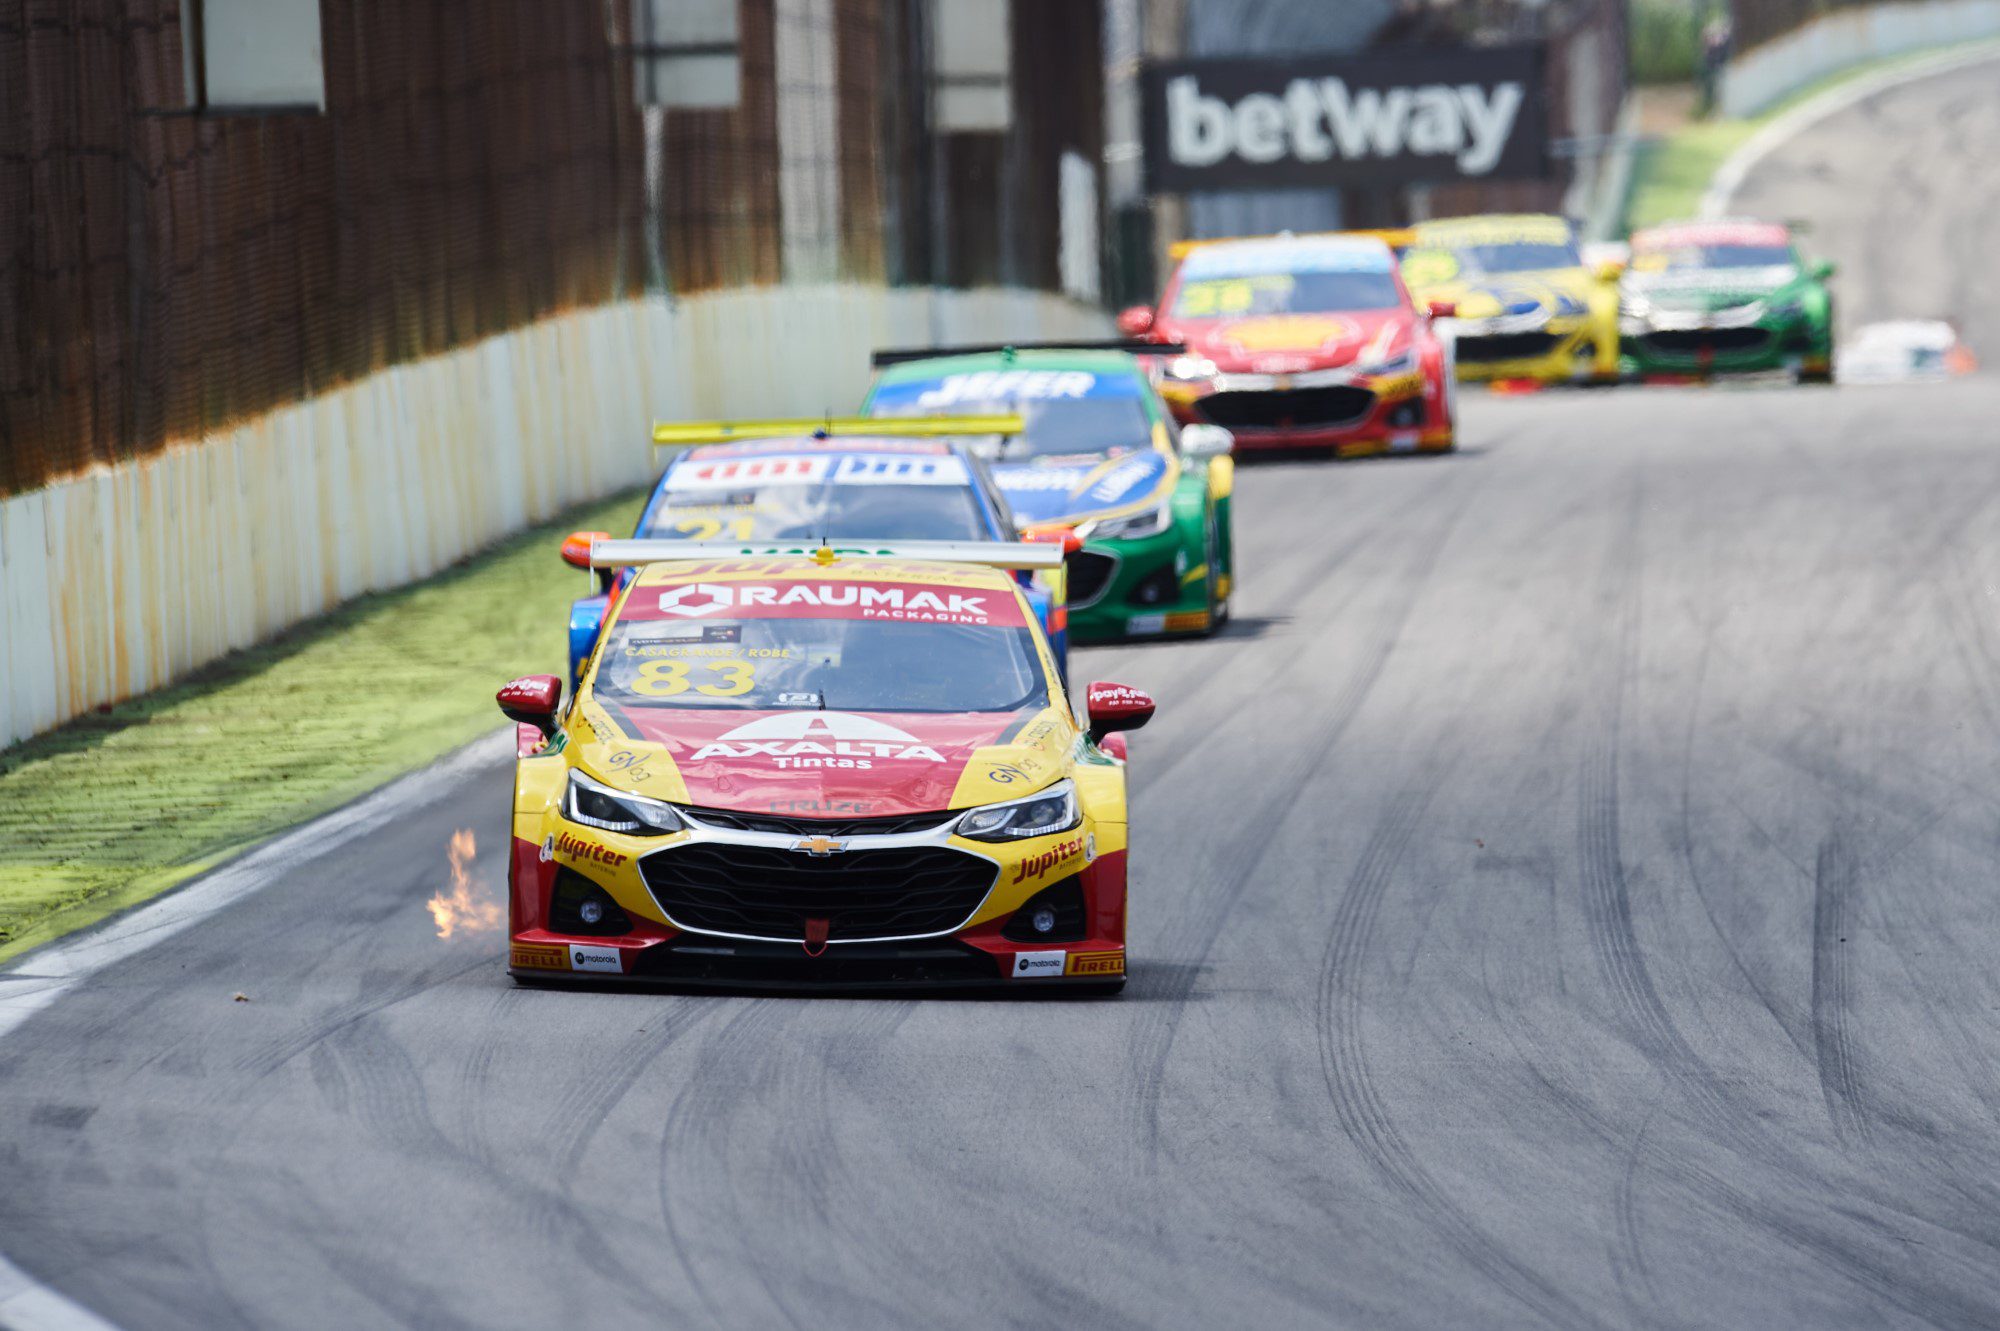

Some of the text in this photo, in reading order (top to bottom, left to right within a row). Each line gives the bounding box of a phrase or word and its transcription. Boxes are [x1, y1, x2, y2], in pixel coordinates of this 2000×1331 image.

[1166, 76, 1523, 174] betway
[740, 585, 988, 615] RAUMAK
[864, 608, 988, 624] PACKAGING
[625, 647, 733, 658] CASAGRANDE
[630, 659, 756, 697] 83
[690, 741, 948, 763] AXALTA
[772, 756, 873, 769] Tintas
[585, 954, 617, 964] motorola
[1029, 957, 1061, 968] motorola
